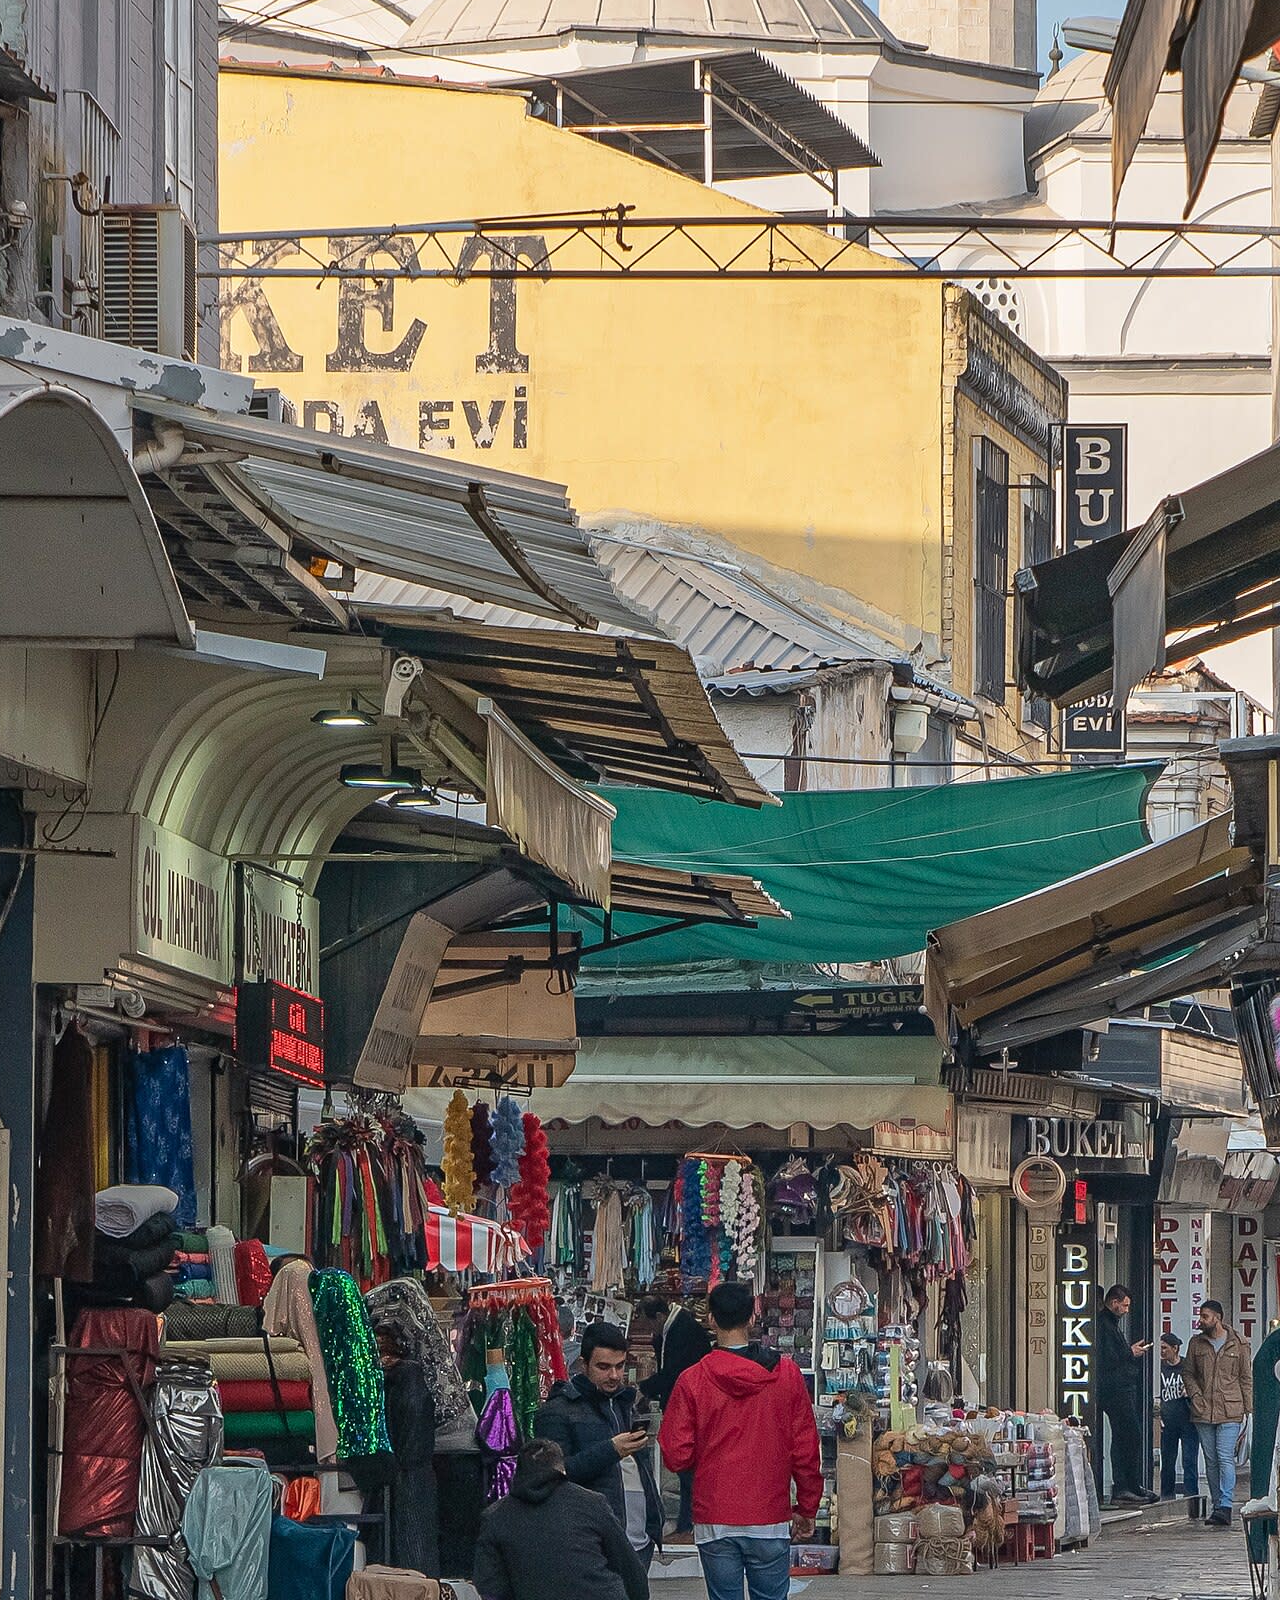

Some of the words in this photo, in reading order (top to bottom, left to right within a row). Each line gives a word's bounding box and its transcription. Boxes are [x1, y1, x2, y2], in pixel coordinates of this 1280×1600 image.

[419, 385, 529, 449] EVİ
[1074, 436, 1115, 550] BU
[1073, 712, 1113, 732] EVİ
[1027, 1116, 1127, 1159] BUKET
[1190, 1219, 1203, 1284] NİKAH
[1030, 1226, 1047, 1355] BUKET
[1061, 1243, 1092, 1420] BUKET
